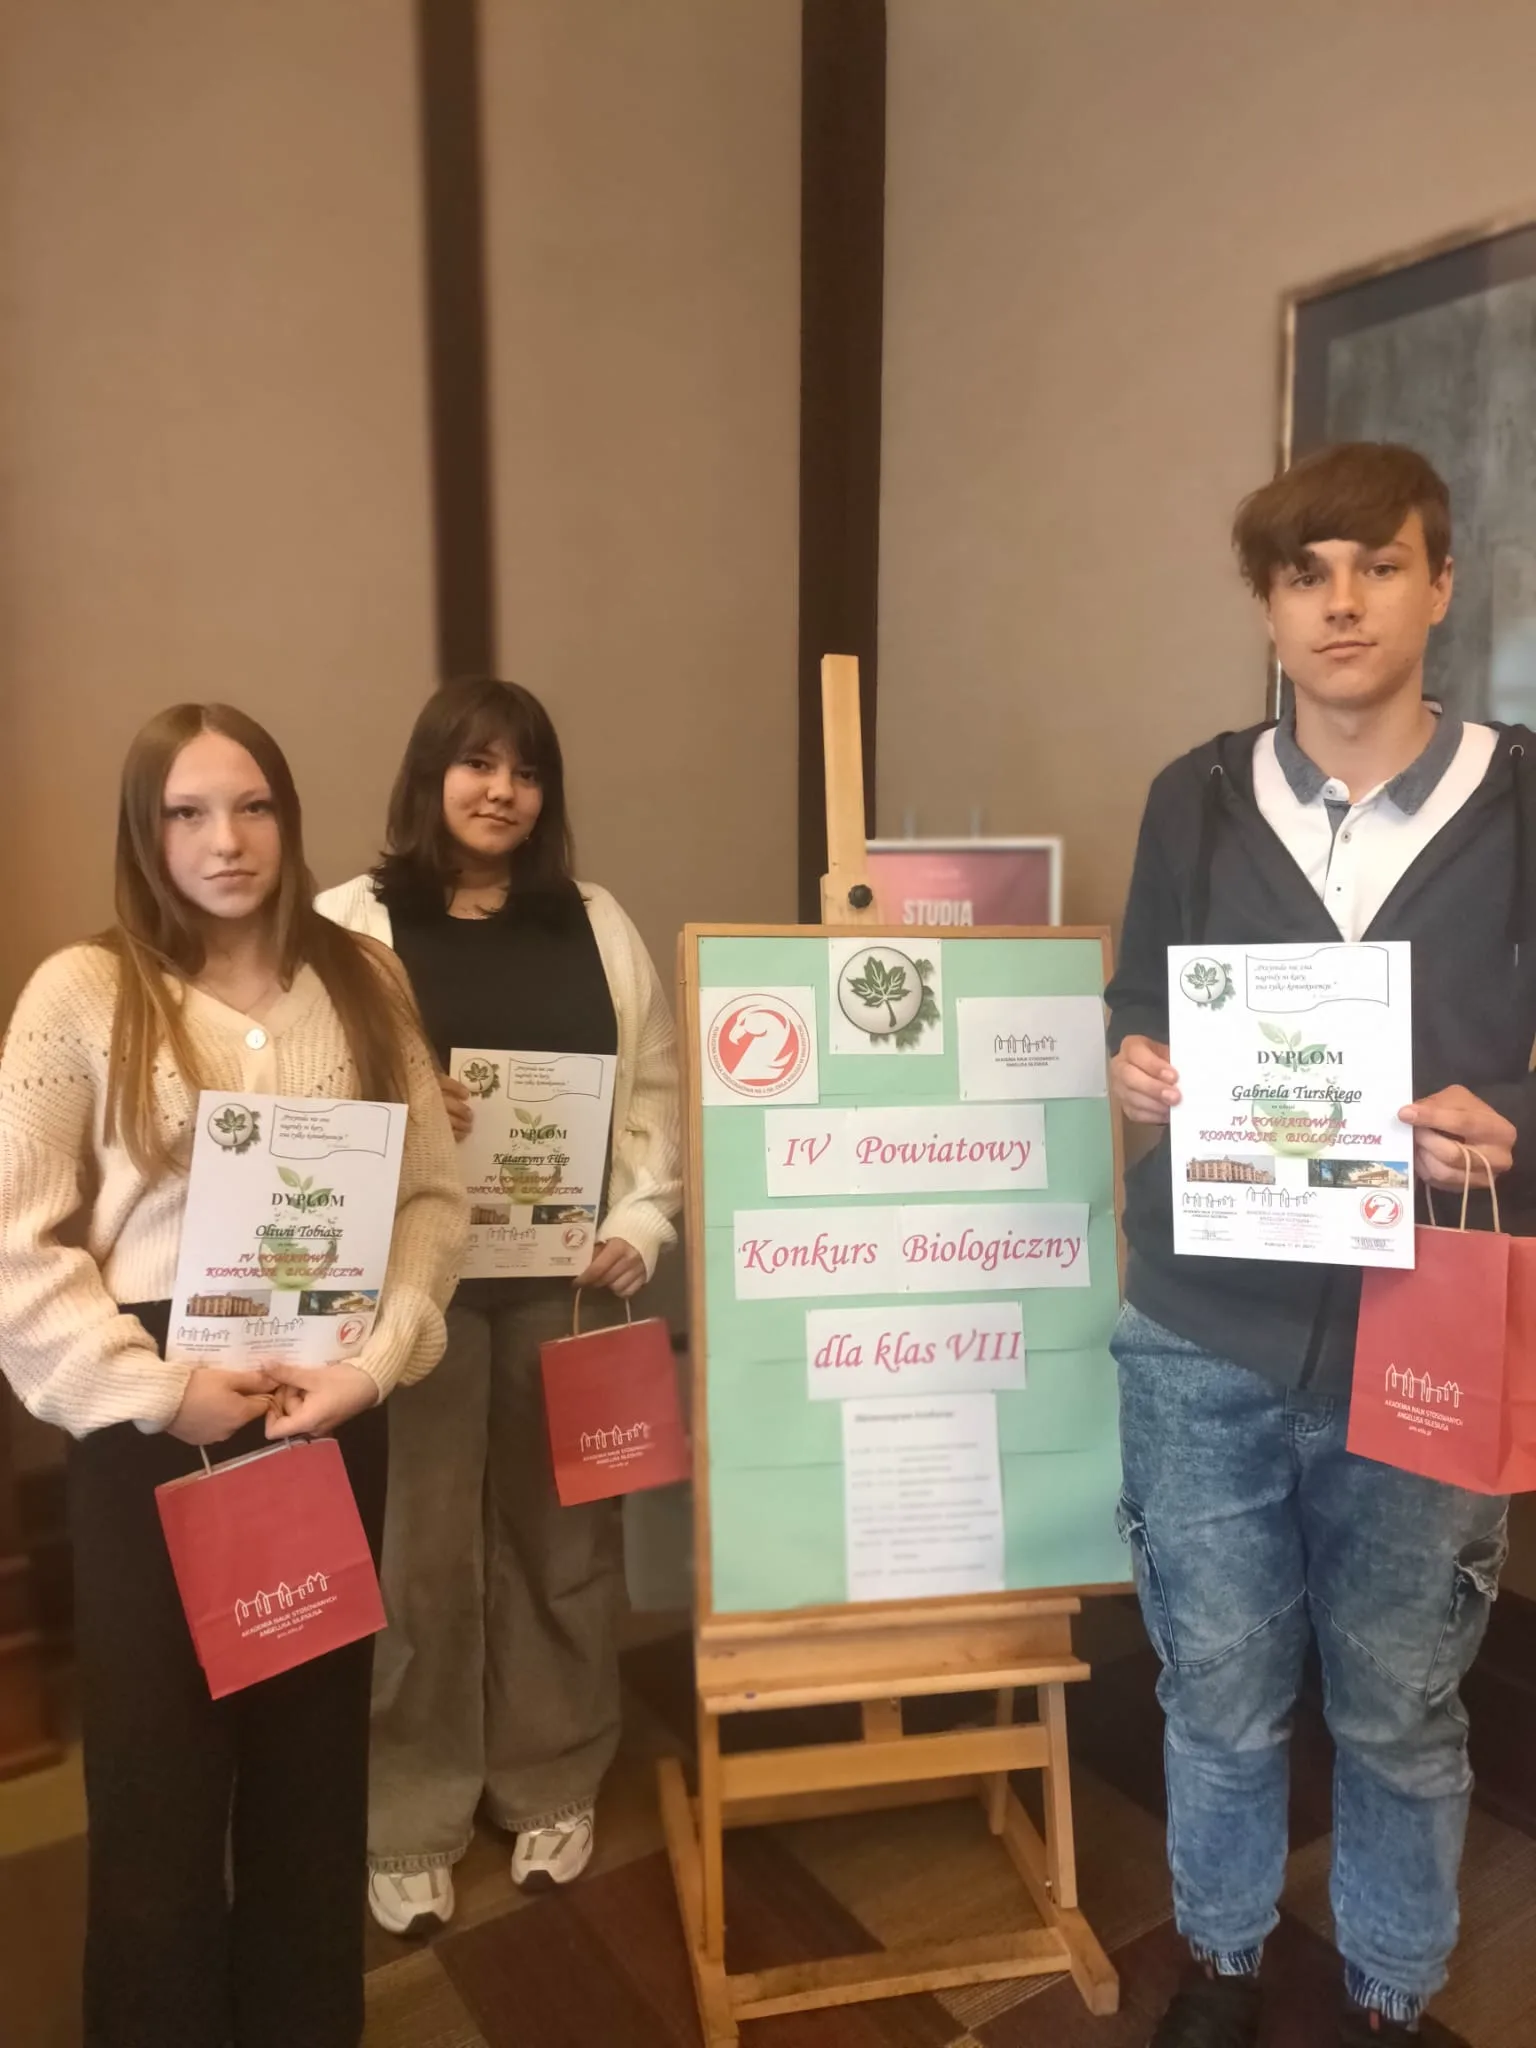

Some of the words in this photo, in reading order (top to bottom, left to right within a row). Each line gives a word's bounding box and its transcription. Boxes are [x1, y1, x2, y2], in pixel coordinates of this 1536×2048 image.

[903, 899, 973, 926] STUDIA
[1257, 1050, 1343, 1065] DYPLOM
[1231, 1084, 1289, 1101] Gabriela
[1293, 1085, 1362, 1103] Turskiego
[1231, 1115, 1248, 1126] IV
[1252, 1115, 1347, 1128] POWIATOWYM
[509, 1128, 567, 1139] DYPLOM
[1199, 1130, 1277, 1142] KONKURSIE
[493, 1153, 545, 1166] Katarzyny
[547, 1153, 570, 1166] Filip
[782, 1133, 832, 1167] IV
[856, 1134, 1031, 1171] Powiatowy
[271, 1192, 345, 1207] DYPLOM
[299, 1225, 344, 1238] Tobiasz
[238, 1253, 255, 1263] IV
[741, 1233, 878, 1274] Konkurs
[902, 1228, 1081, 1271] Biologiczny
[814, 1334, 863, 1368] dla
[874, 1331, 936, 1373] klas
[946, 1329, 1022, 1362] VIII
[1384, 1399, 1411, 1411] AKADEMIA
[1412, 1405, 1425, 1416] NAUK
[241, 1620, 272, 1637] AKADEMIA
[273, 1613, 290, 1624] NAUK
